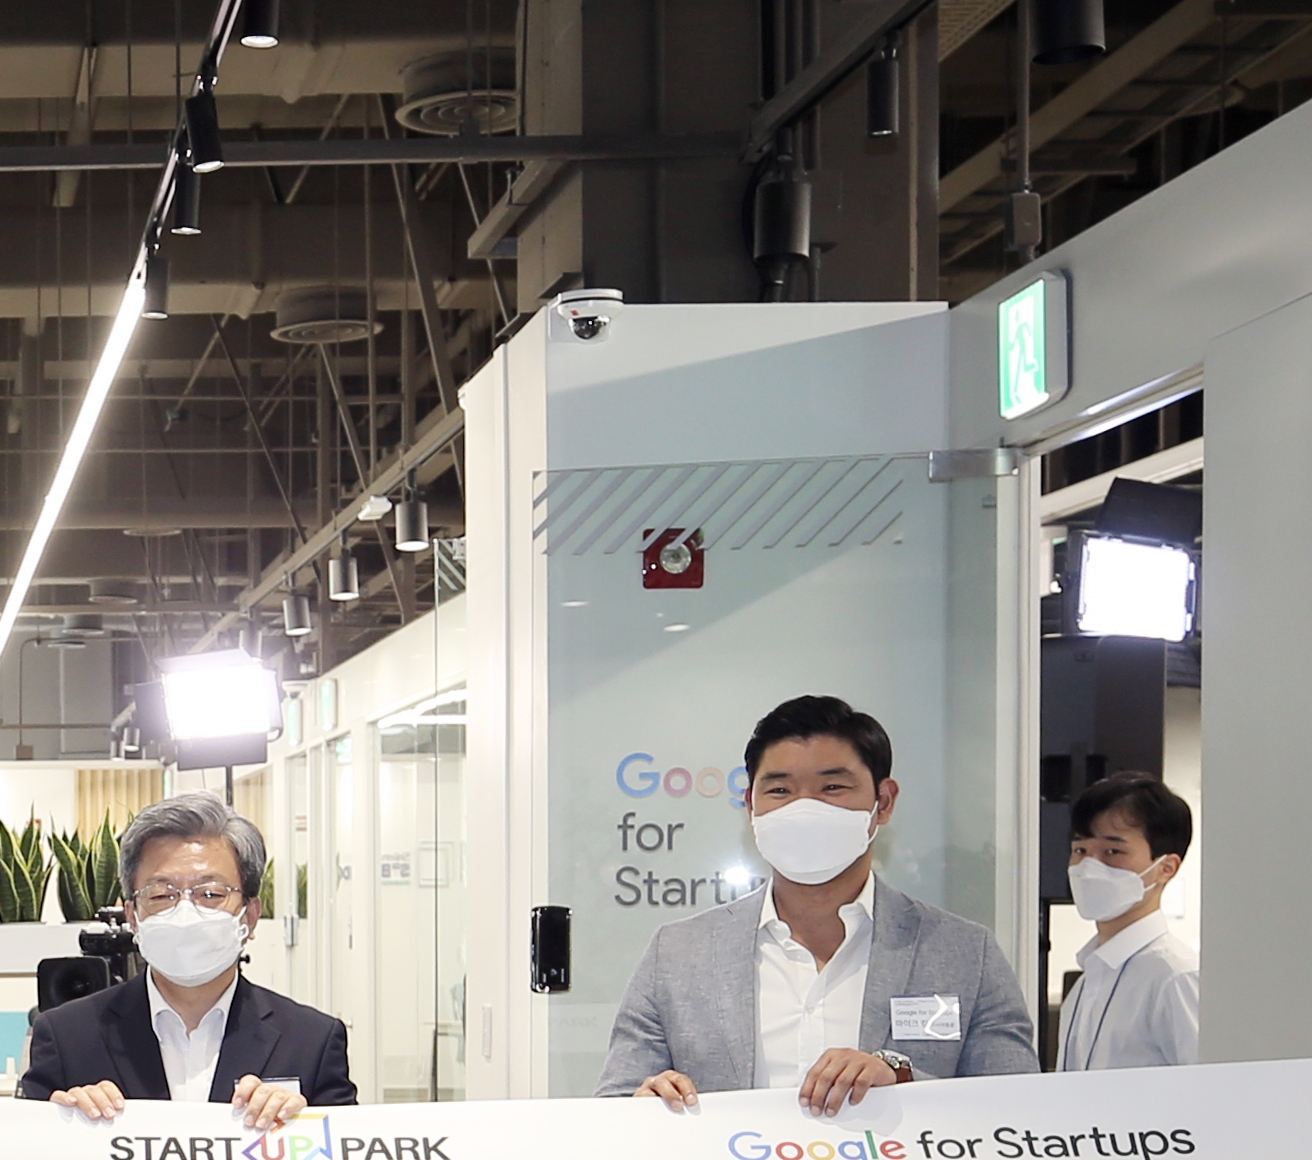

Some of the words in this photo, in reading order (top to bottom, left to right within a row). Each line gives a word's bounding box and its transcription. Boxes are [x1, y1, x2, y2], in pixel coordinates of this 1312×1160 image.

[615, 752, 749, 809] Goog
[617, 812, 685, 852] for
[614, 866, 767, 907] Start
[916, 1130, 983, 1160] for
